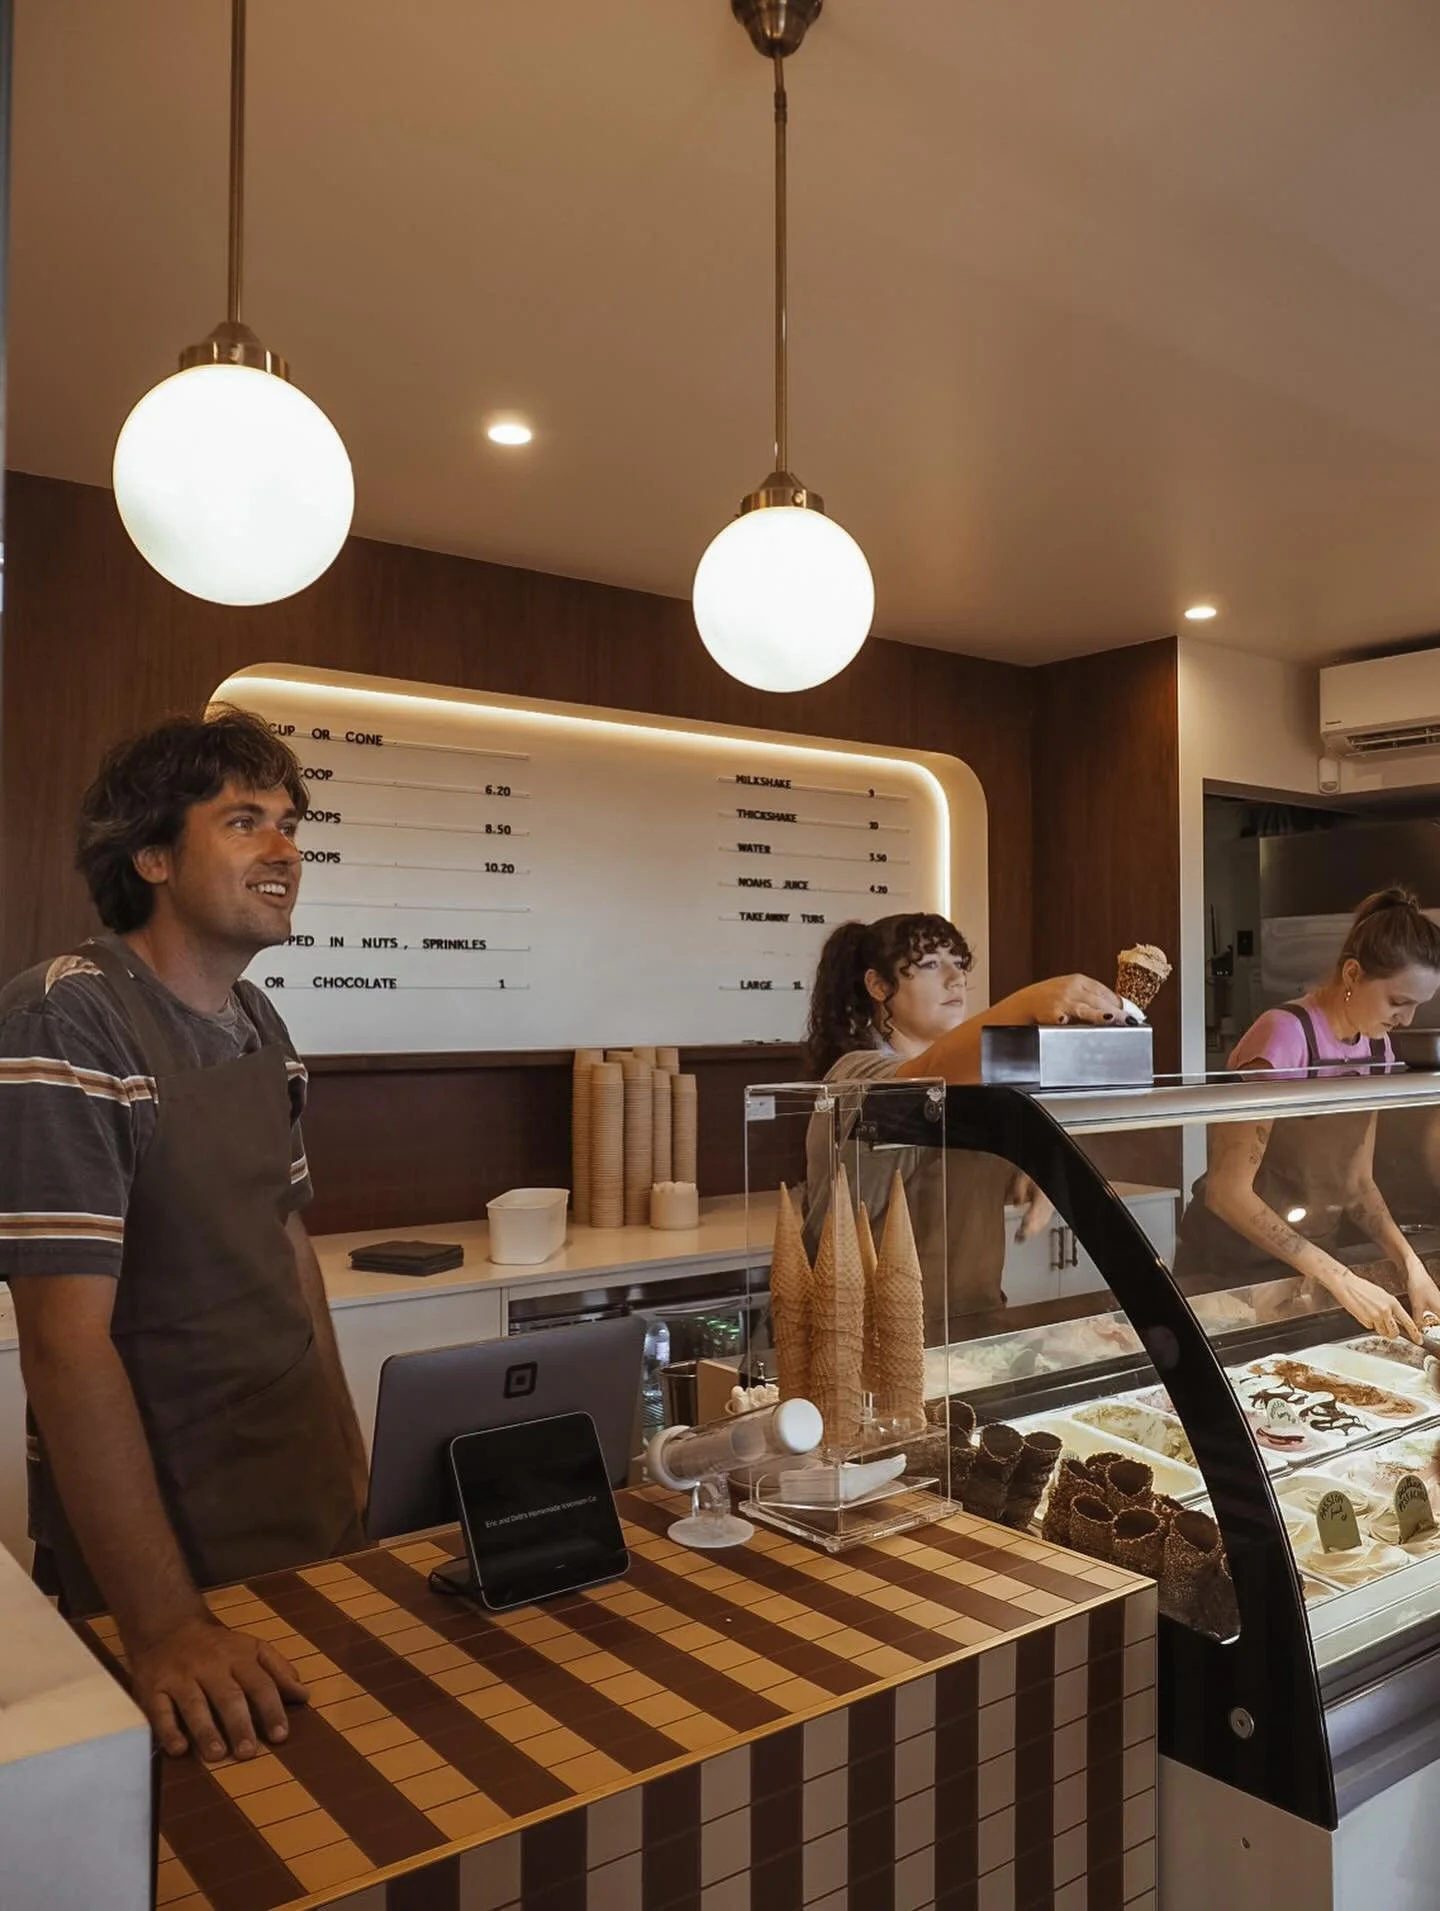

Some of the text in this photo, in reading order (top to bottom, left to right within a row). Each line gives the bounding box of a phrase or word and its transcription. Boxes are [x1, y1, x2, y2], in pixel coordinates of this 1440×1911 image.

[268, 723, 383, 746] CUP OR CONE
[736, 774, 792, 789] MILKSHAKE
[485, 785, 511, 797] 6.20
[303, 810, 511, 835] OOPS 8.50
[736, 808, 798, 823] THICKSHAKE
[737, 843, 771, 854] WATER
[484, 862, 515, 874] 10.20
[739, 877, 772, 888] NOAHS
[869, 884, 888, 895] 4.20
[288, 935, 315, 947] PED
[329, 936, 345, 948] IN
[422, 938, 487, 950] SPRINKLES
[264, 976, 506, 989] OR CHOCOLATE 1
[740, 980, 774, 990] LARGE
